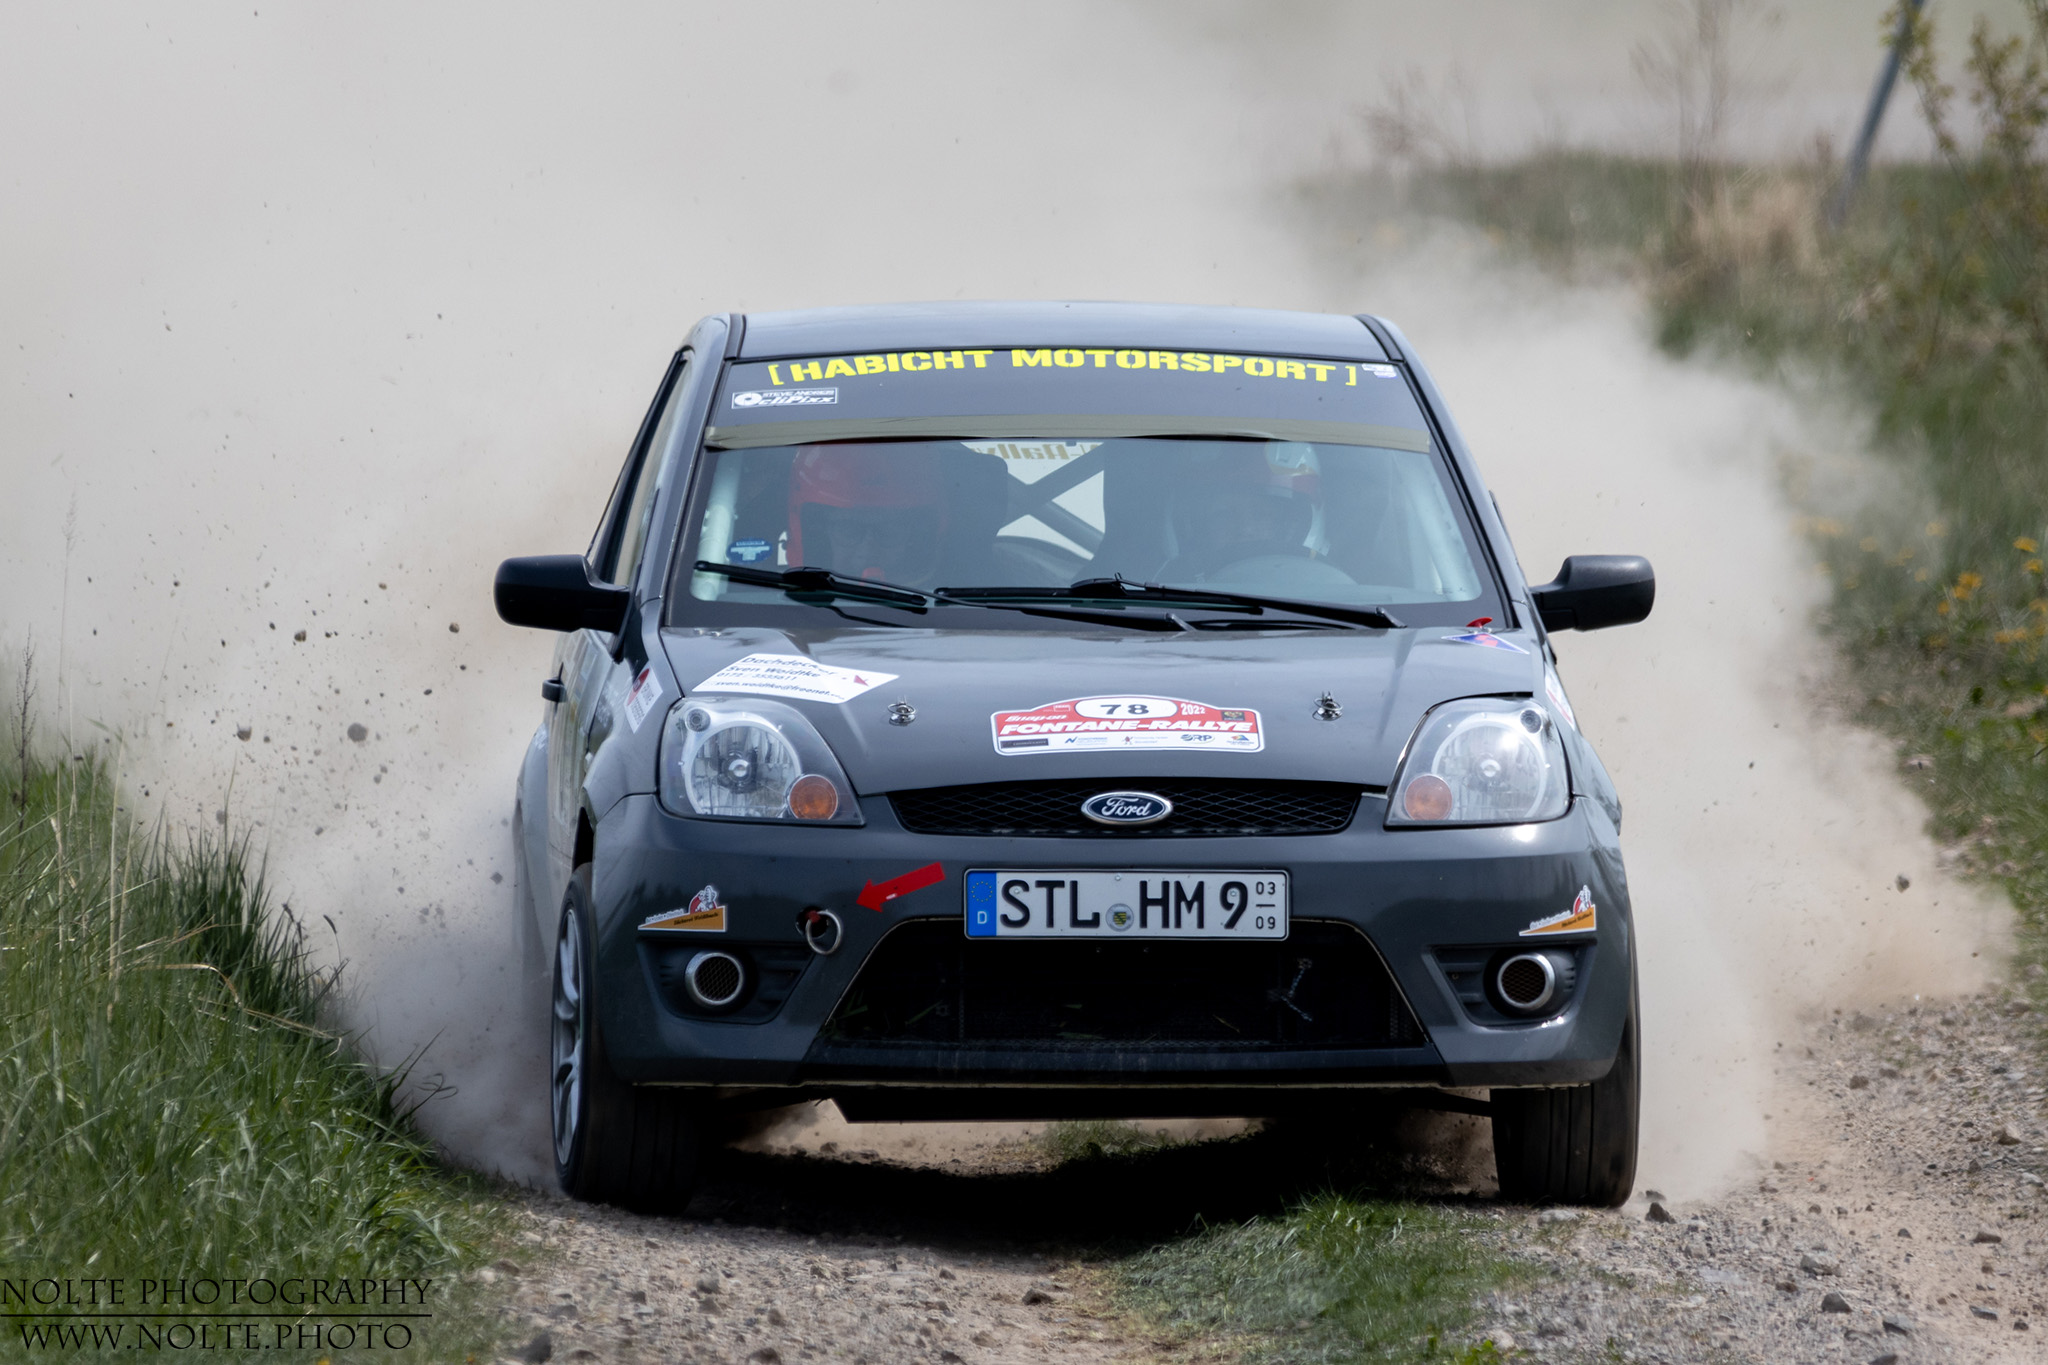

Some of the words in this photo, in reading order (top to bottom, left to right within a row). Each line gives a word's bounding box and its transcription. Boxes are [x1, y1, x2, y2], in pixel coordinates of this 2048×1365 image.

[1100, 704, 1149, 715] 78
[1180, 703, 1206, 715] 2022
[999, 720, 1253, 735] FONTANE-RALLYE
[1101, 797, 1151, 816] Ford
[1255, 881, 1276, 895] 03
[1000, 880, 1100, 928] STL
[1139, 880, 1204, 929] HM
[1219, 880, 1249, 929] 9
[977, 911, 987, 925] D
[1255, 916, 1276, 930] 09
